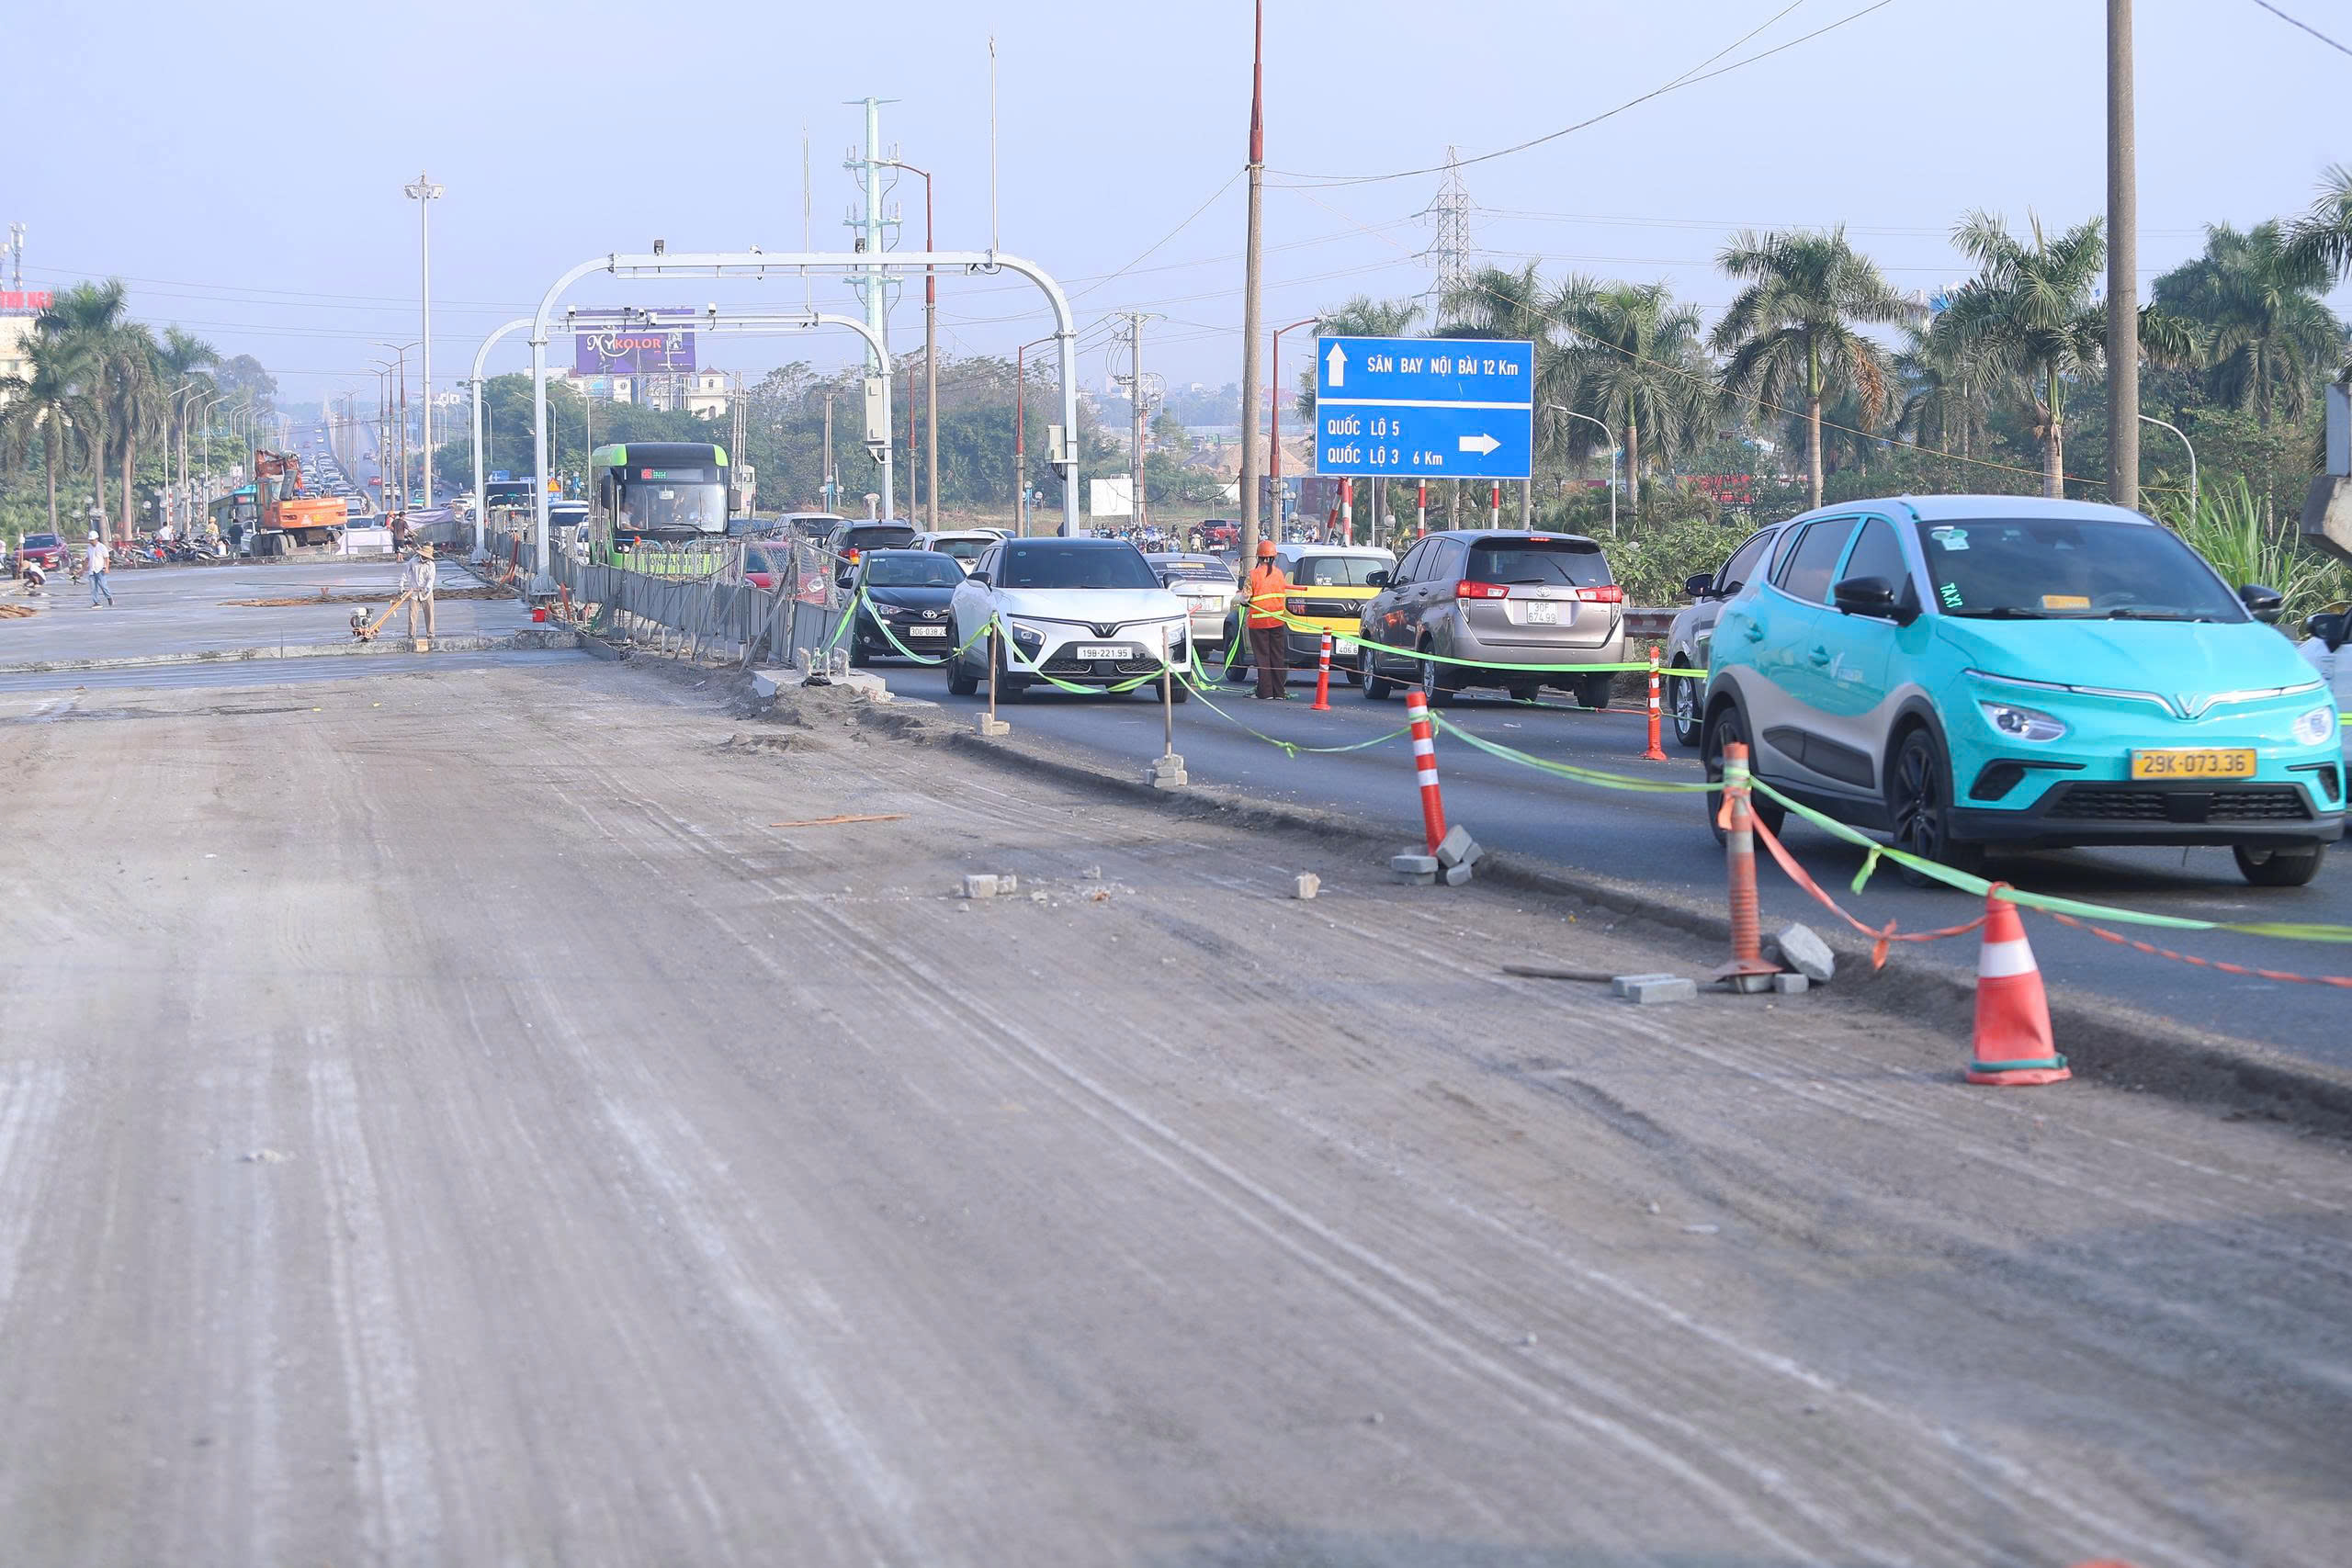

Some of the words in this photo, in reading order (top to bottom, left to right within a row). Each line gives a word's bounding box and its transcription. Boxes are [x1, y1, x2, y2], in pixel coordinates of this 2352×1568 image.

[1367, 355, 1393, 373] SÂN
[1400, 358, 1423, 373] BAY
[1430, 355, 1452, 378] NỘI
[1458, 355, 1477, 375] BÀI
[1483, 360, 1495, 376] 12
[1498, 360, 1519, 376] Km
[1328, 414, 1361, 436] QUỐC
[1370, 418, 1386, 439] LỘ
[1392, 421, 1399, 436] 5
[1328, 442, 1361, 464] QUỐC
[1370, 446, 1385, 467] LỘ
[1391, 448, 1399, 464] 3
[1413, 450, 1419, 465] 6
[1424, 451, 1442, 466] Km
[1939, 582, 1963, 608] TAXI
[2144, 755, 2245, 773] 29K-073.36
